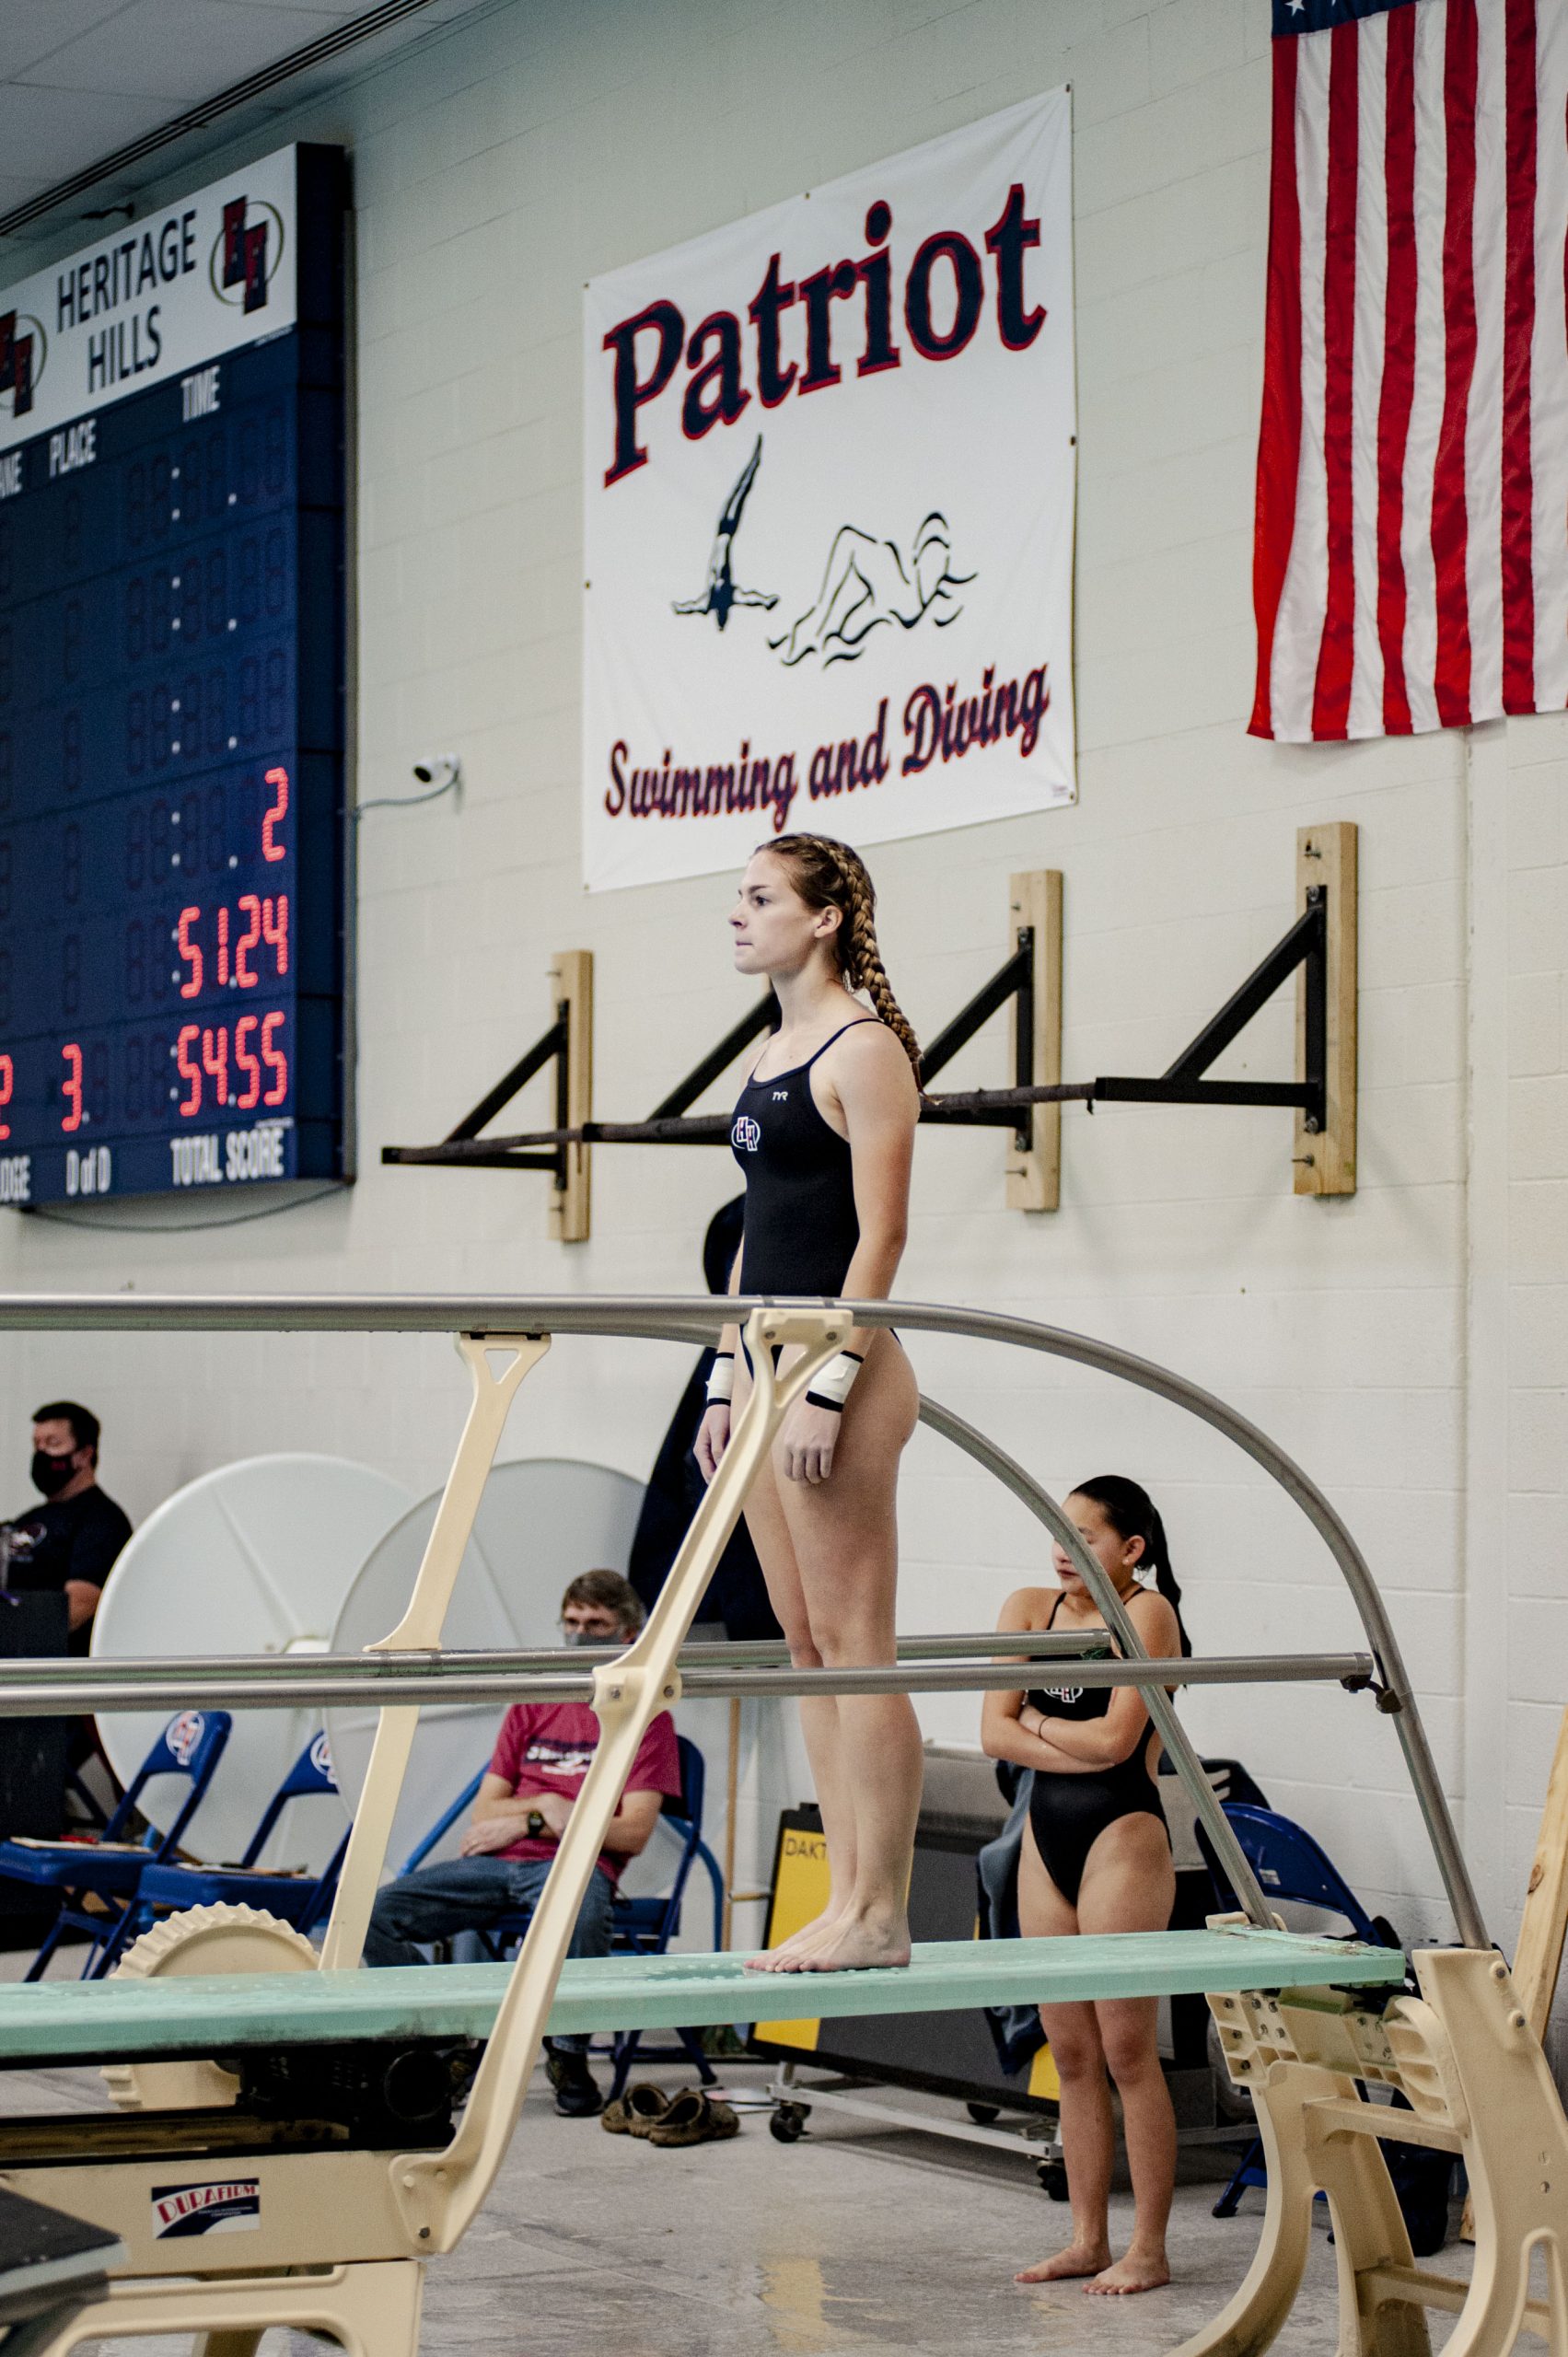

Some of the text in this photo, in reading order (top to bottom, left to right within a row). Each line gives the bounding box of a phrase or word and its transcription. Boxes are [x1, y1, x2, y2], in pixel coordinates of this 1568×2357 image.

[57, 209, 197, 334] HERITAGE
[88, 304, 161, 394] HILLS
[603, 182, 1048, 488] Patriot
[50, 419, 97, 479] PLACE
[180, 366, 220, 424] TIME
[603, 661, 1051, 833] Swimming and Diving
[262, 767, 289, 862] 2
[772, 1091, 788, 1101] TYR
[170, 1133, 223, 1186] TOTAL
[226, 1127, 285, 1181] SCORE
[157, 2185, 256, 2224] DURAFIRM
